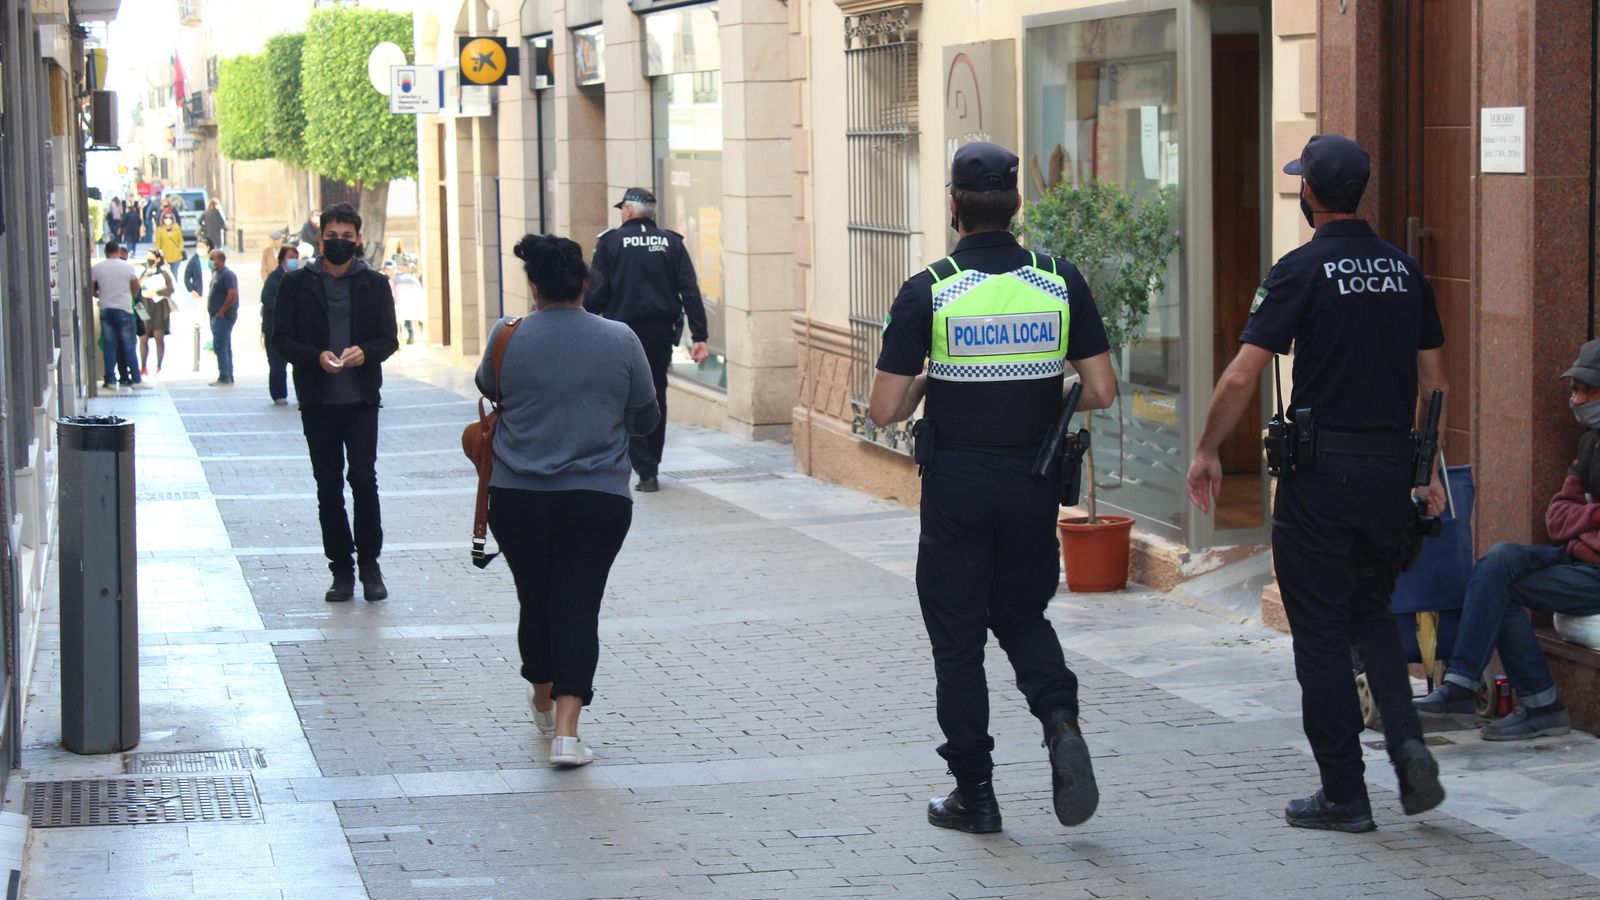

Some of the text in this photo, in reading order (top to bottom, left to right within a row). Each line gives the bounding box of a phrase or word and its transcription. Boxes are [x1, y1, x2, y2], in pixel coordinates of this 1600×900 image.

[622, 235, 669, 248] POLICIA
[1323, 257, 1410, 279] POLICIA
[1337, 276, 1408, 295] LOCAL
[954, 321, 1056, 346] POLICIA LOCAL
